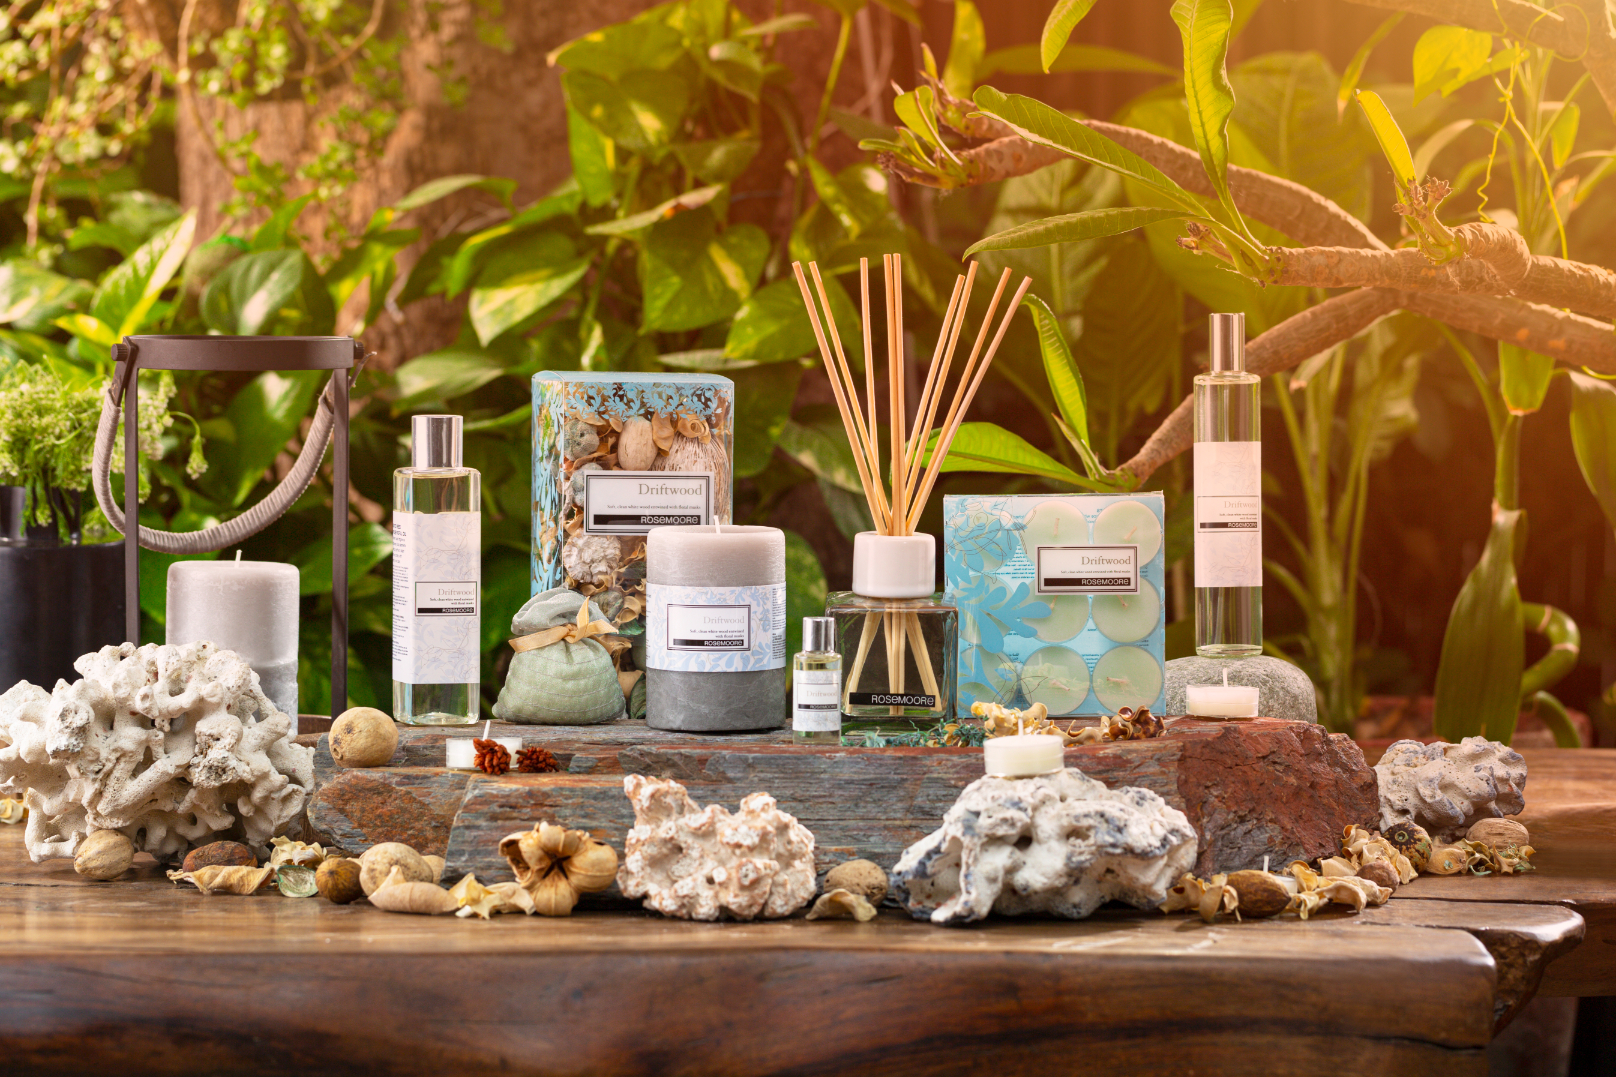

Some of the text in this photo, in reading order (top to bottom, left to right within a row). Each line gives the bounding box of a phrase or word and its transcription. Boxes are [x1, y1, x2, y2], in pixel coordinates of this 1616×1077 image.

[638, 483, 703, 496] Driftwood
[1081, 555, 1131, 565] Driftwood
[438, 588, 475, 596] Driftwood
[703, 615, 745, 624] Driftwood
